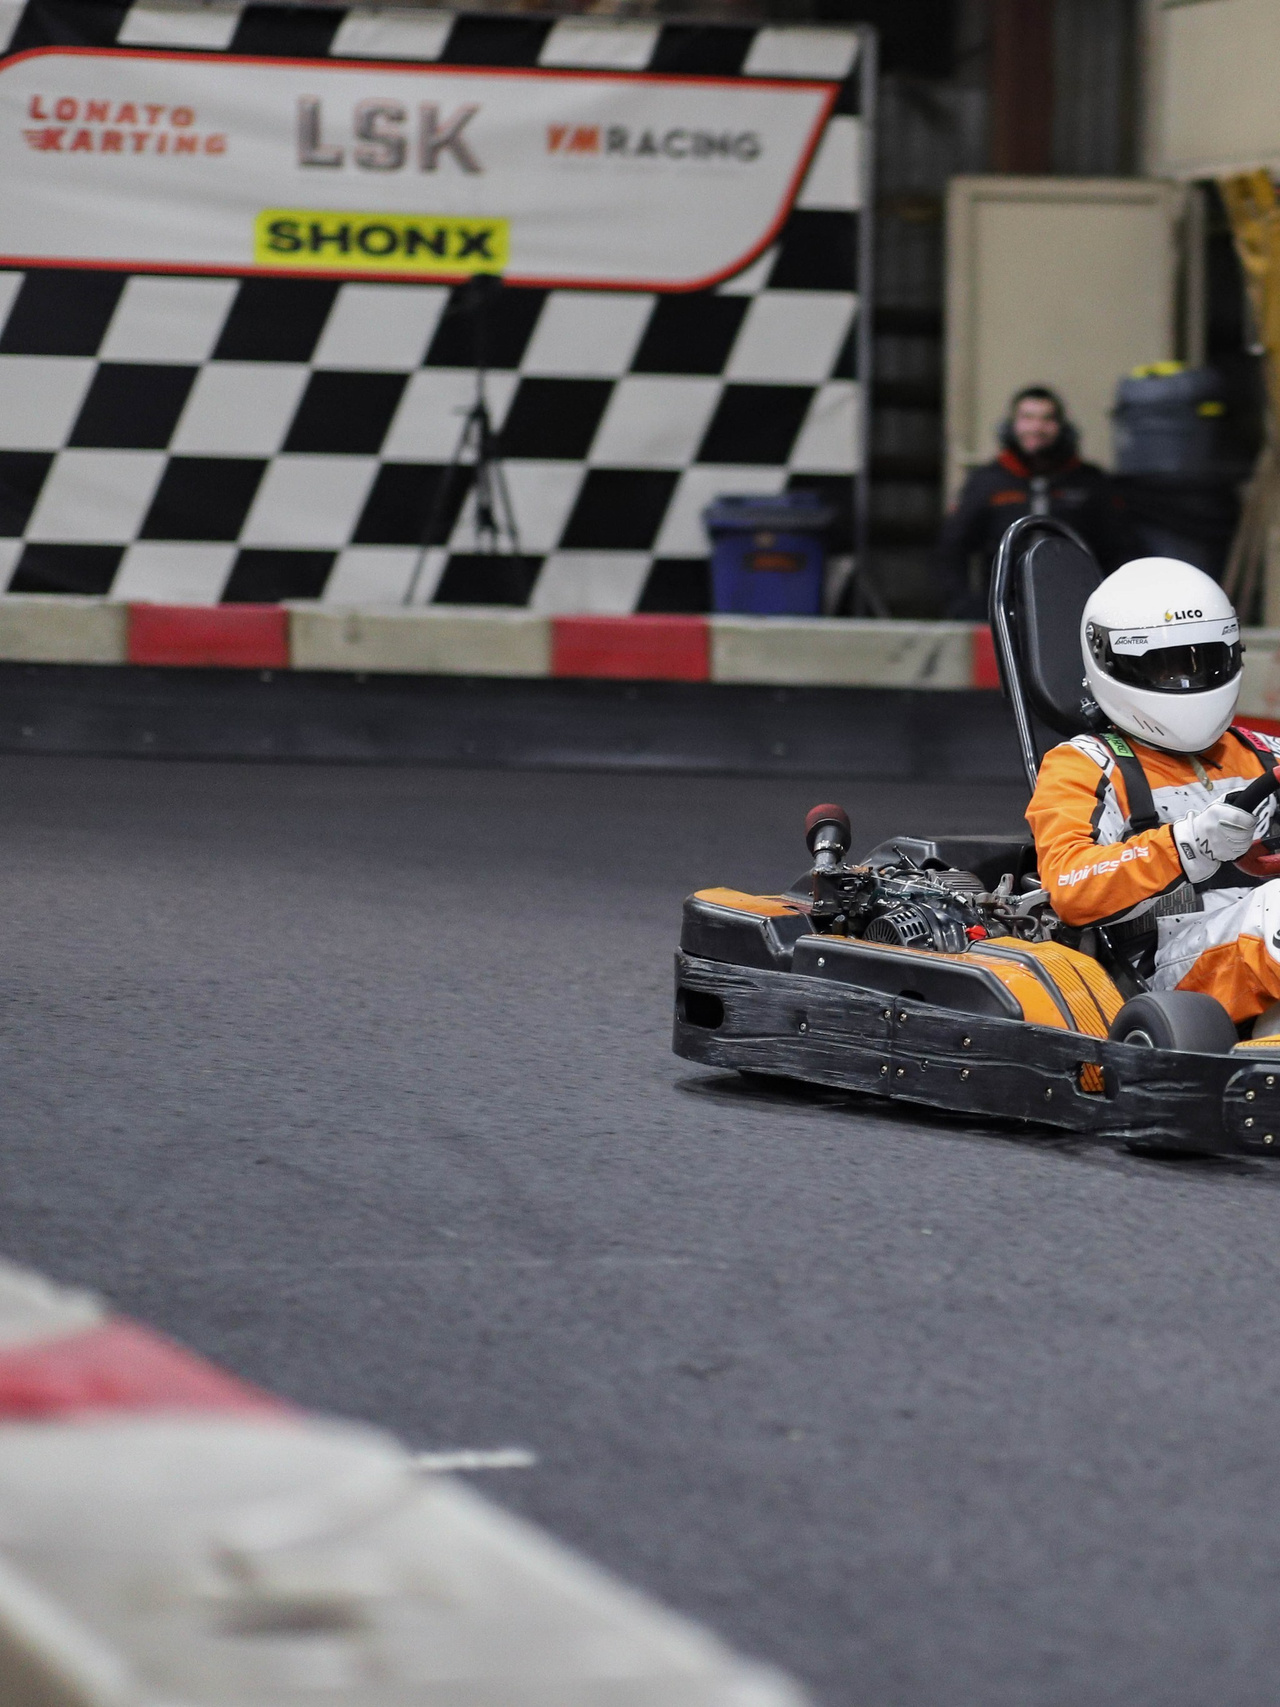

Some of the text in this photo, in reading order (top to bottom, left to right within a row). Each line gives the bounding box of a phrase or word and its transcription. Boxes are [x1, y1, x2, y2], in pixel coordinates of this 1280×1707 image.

[28, 95, 195, 128] LONATO
[22, 128, 227, 155] KARTING
[296, 95, 485, 175] LSK
[267, 218, 495, 260] SHONX
[1175, 609, 1203, 620] LICO
[1115, 637, 1149, 646] MONTERA
[1057, 846, 1149, 887] alpinesars
